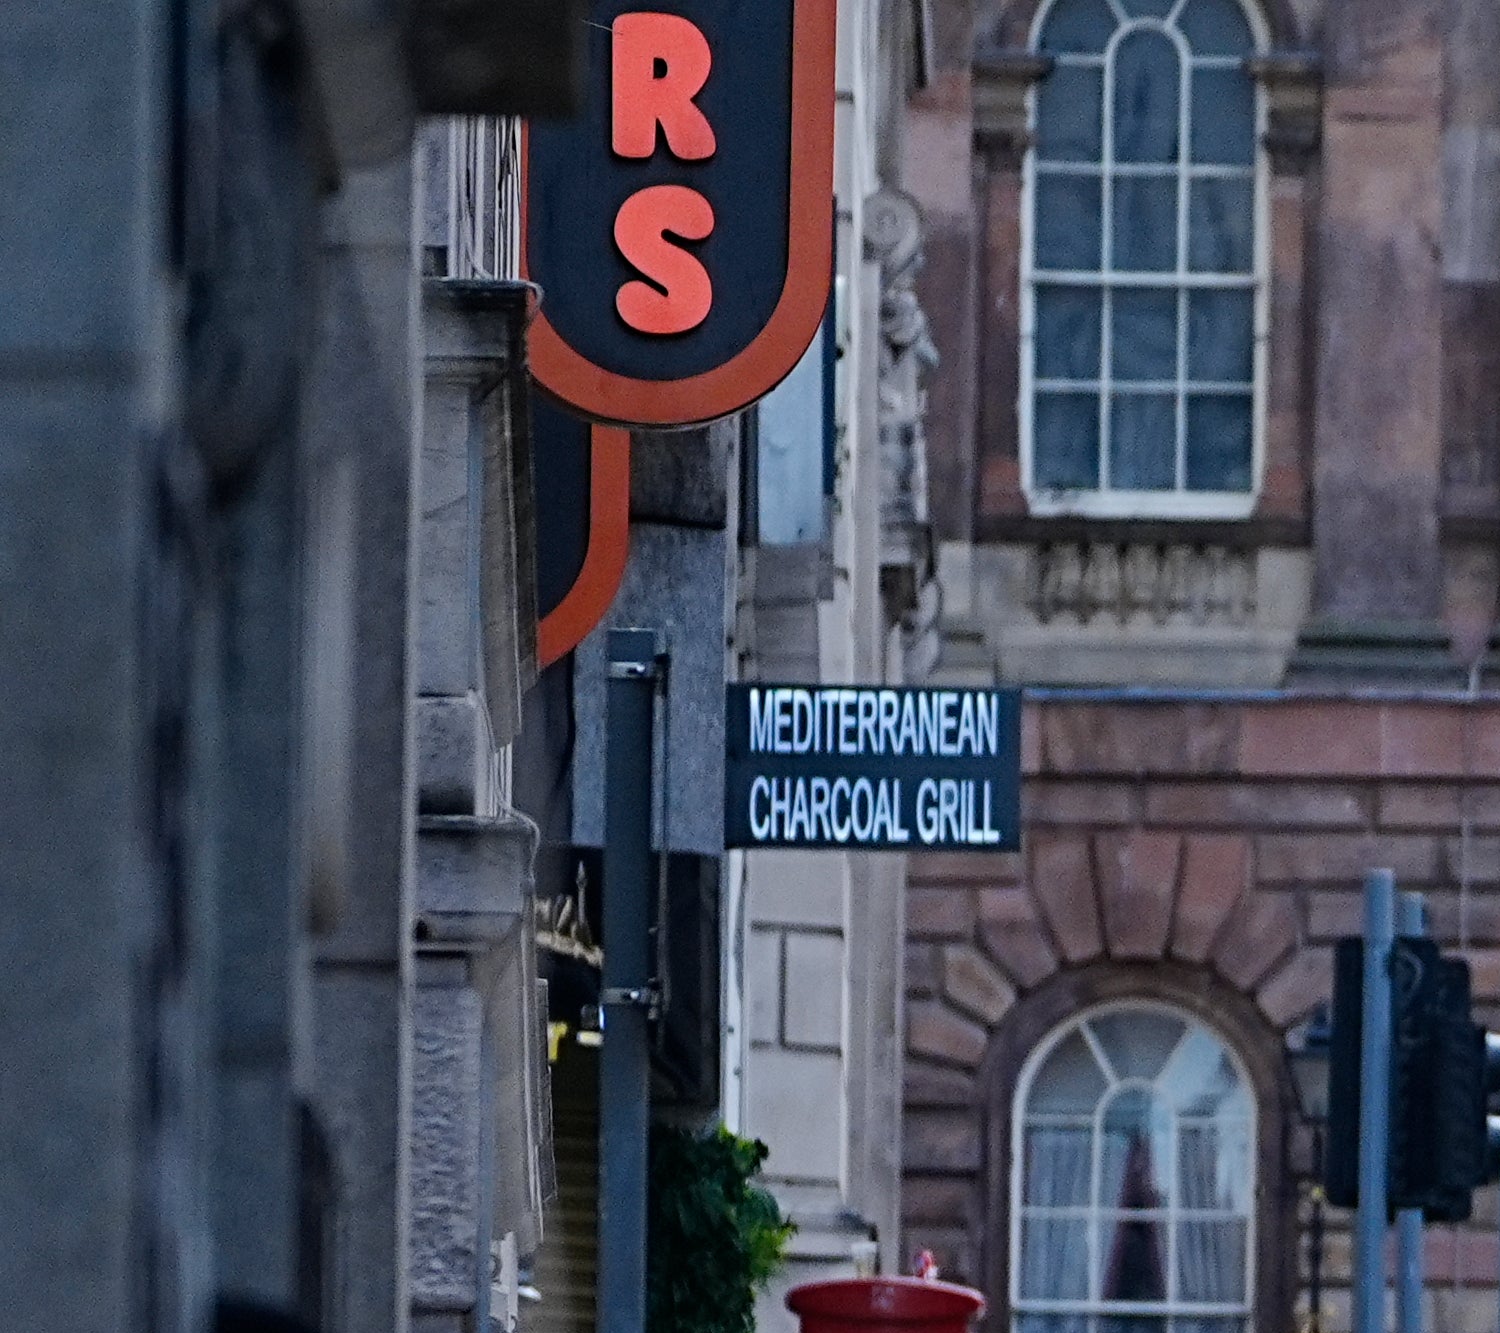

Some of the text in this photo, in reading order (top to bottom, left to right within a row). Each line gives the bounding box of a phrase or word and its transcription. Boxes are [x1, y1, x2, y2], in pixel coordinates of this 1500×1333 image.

[748, 688, 998, 755] MEDITERRANEAN
[748, 776, 1001, 845] CHARCOAL GRILL
